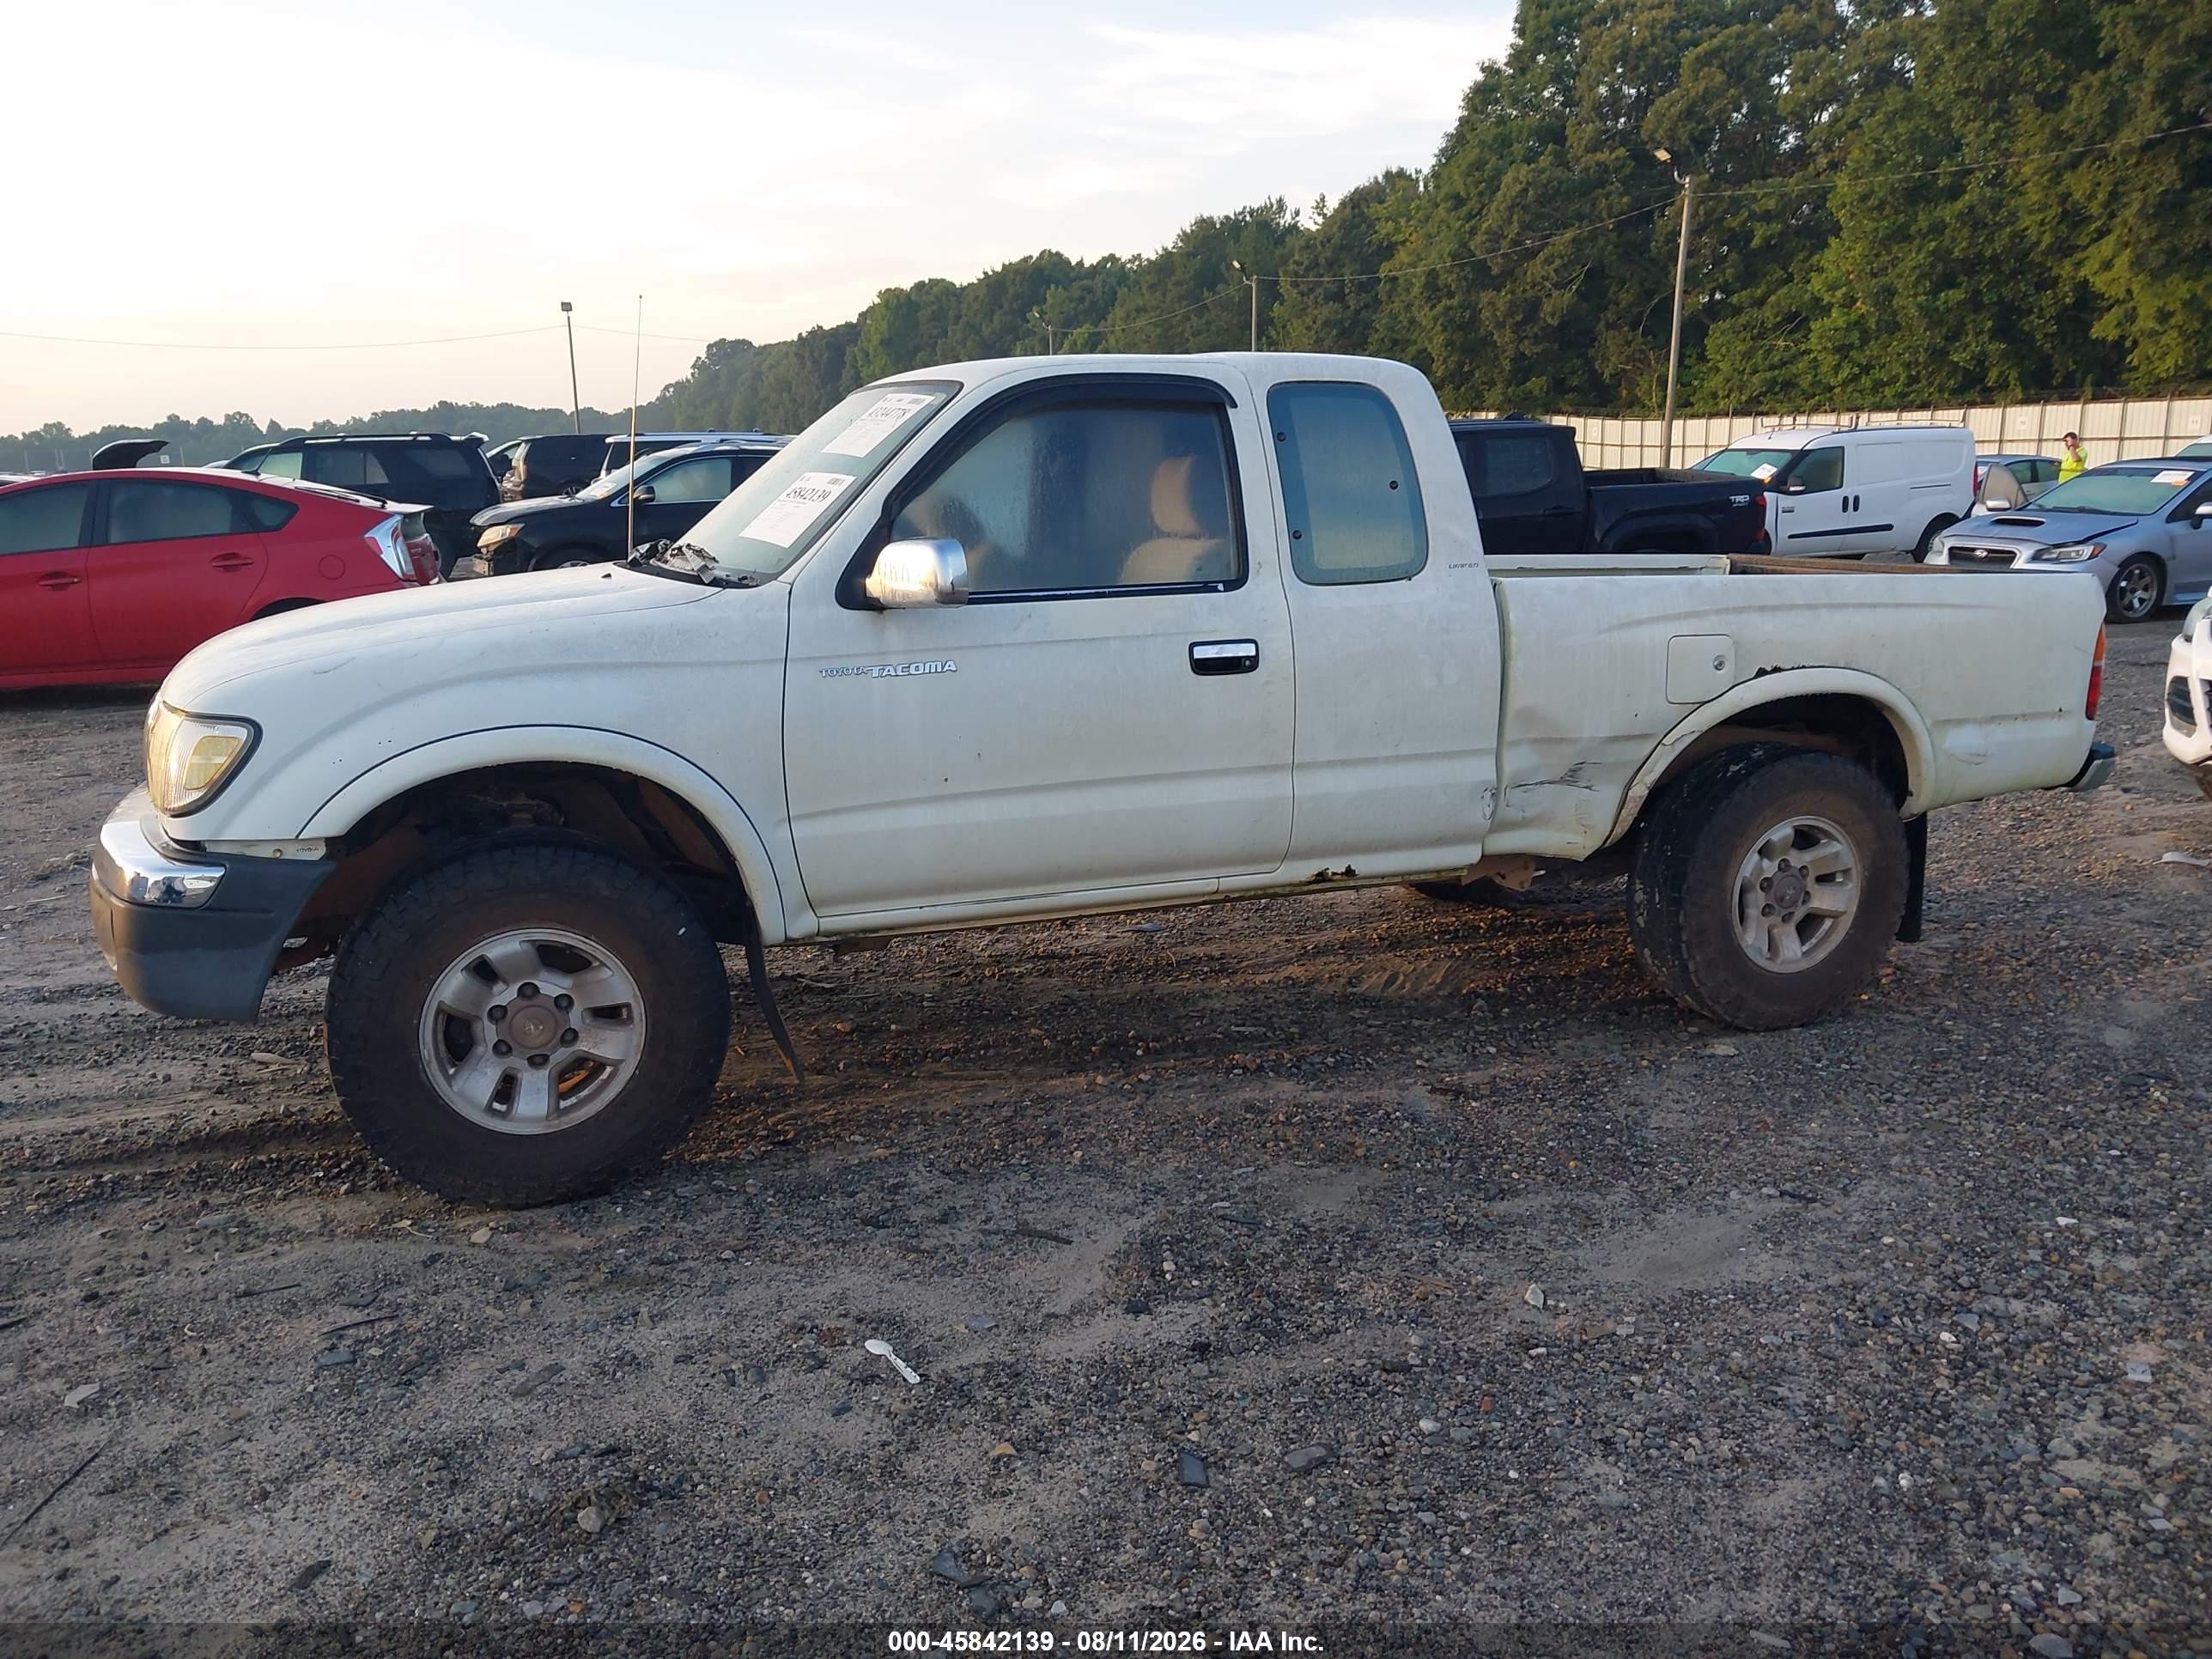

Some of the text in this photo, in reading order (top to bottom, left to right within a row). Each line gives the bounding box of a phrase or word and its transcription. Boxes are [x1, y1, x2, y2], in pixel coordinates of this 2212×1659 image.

[786, 486, 831, 503] 45842139
[1729, 495, 1750, 503] TRD
[819, 659, 957, 678] TOYOTA TACOMA
